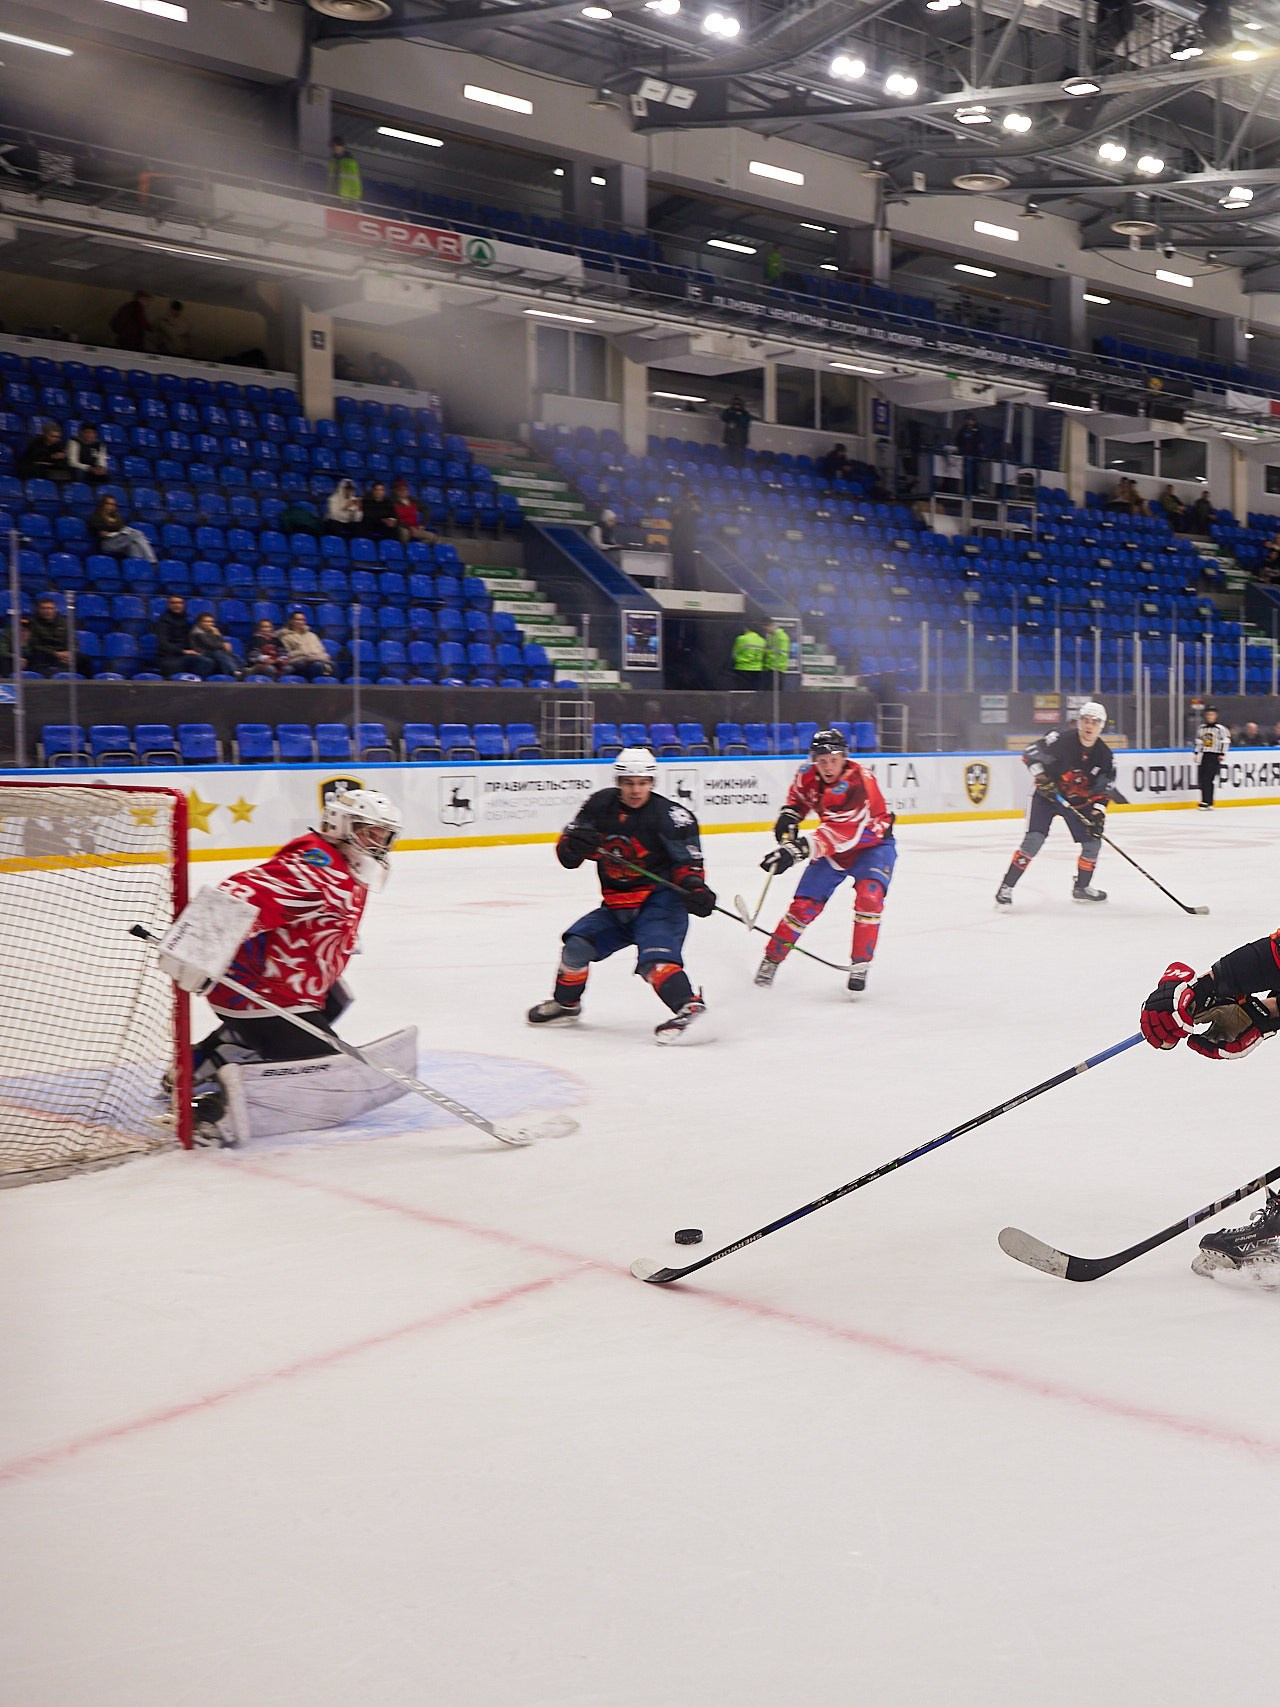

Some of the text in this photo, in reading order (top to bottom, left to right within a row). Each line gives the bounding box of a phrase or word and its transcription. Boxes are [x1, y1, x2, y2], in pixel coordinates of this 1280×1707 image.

[357, 220, 462, 257] SPAR
[484, 779, 593, 793] ПРАВИТЕЛЬСТВО
[704, 775, 760, 790] НИЖНИЙ
[704, 793, 769, 806] НОВГОРОД
[262, 1064, 332, 1078] BAUER
[382, 1066, 487, 1127] BAUER
[710, 1232, 763, 1262] SHERWOOD
